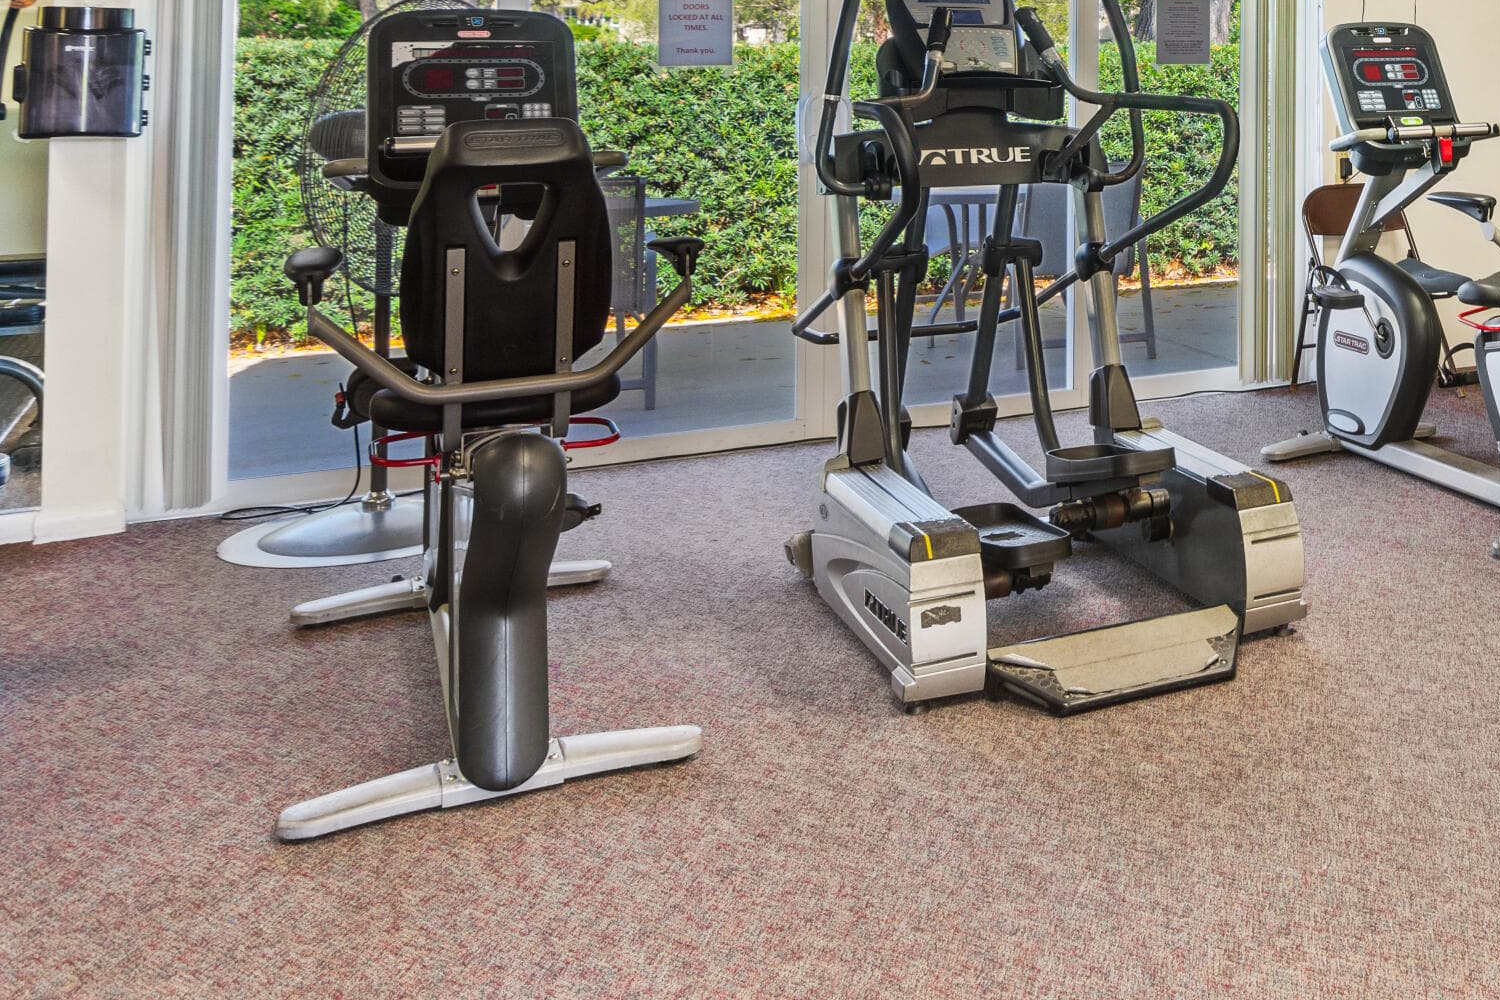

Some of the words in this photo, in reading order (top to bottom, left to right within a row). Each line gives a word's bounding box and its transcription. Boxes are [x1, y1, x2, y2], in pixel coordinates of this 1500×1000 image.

[946, 146, 1032, 165] TRUE
[1336, 335, 1351, 345] STAR
[1351, 339, 1367, 350] TRAC
